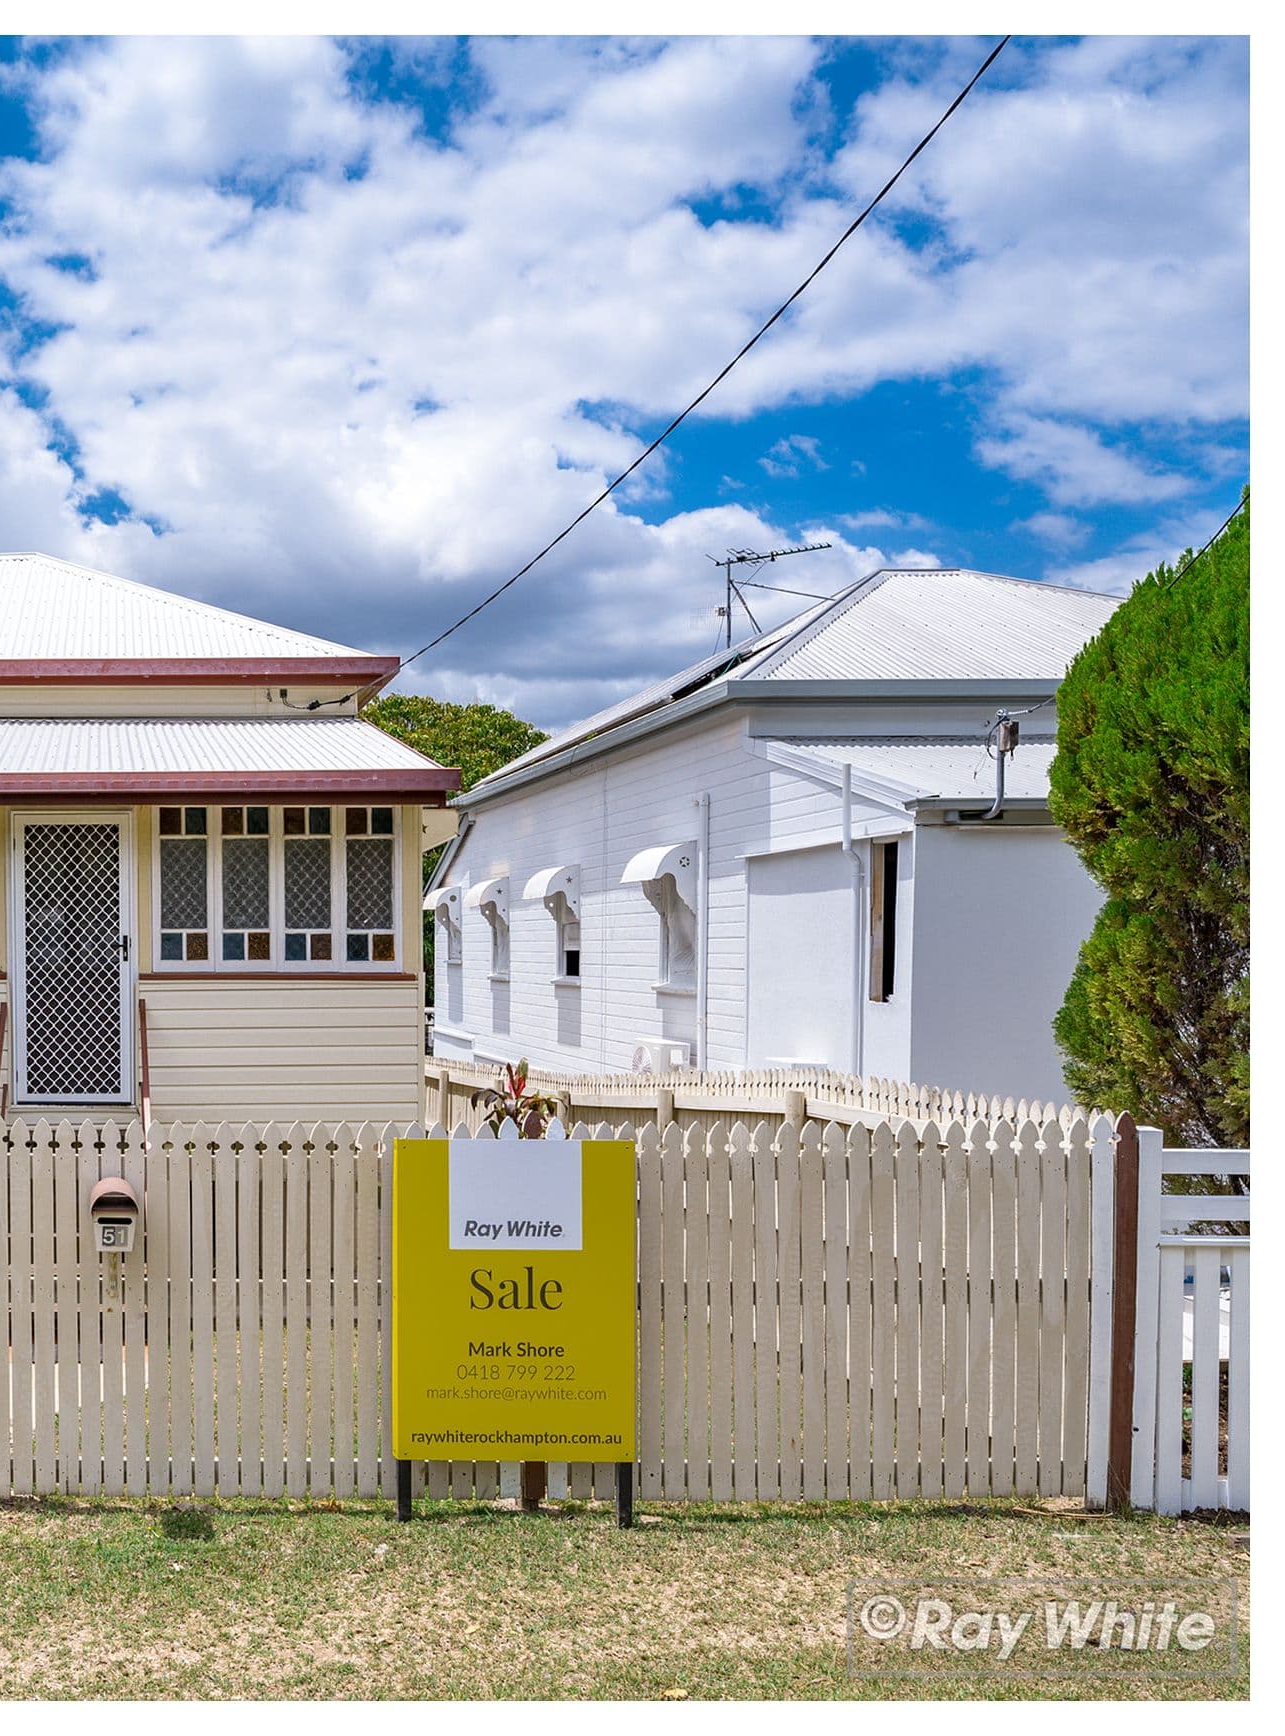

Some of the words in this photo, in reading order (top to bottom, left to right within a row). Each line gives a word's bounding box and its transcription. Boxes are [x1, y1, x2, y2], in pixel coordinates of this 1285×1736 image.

[102, 1228, 126, 1245] 51
[464, 1219, 503, 1241] Ray
[507, 1219, 564, 1238] White
[469, 1266, 564, 1311] Sale
[468, 1341, 512, 1358] Mark
[516, 1341, 565, 1358] Shore
[456, 1364, 500, 1381] 0418
[506, 1364, 538, 1381] 799
[543, 1364, 576, 1382] 222
[426, 1386, 607, 1402] mark.shore@raywhite.com
[411, 1429, 623, 1446] raywhiterockhampton.com.au
